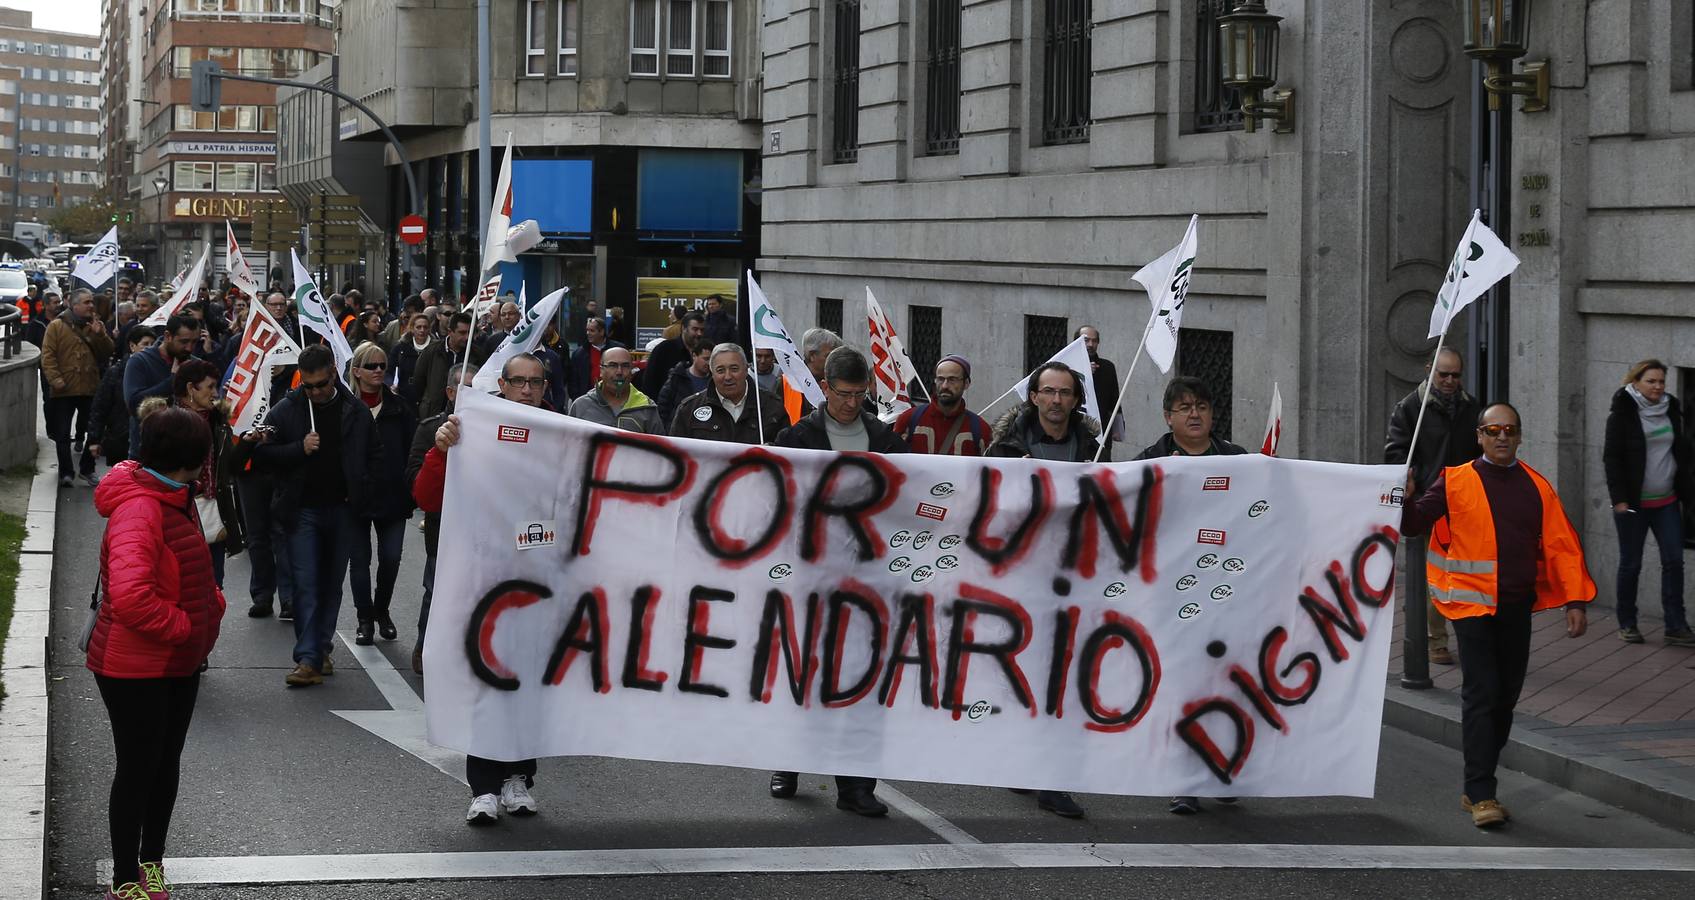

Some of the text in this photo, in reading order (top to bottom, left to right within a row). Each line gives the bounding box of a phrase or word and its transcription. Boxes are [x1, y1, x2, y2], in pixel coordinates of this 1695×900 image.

[503, 428, 525, 437] CCOO
[570, 430, 1164, 584] POR UN
[922, 505, 943, 515] CCOO
[1201, 531, 1221, 539] CCOO
